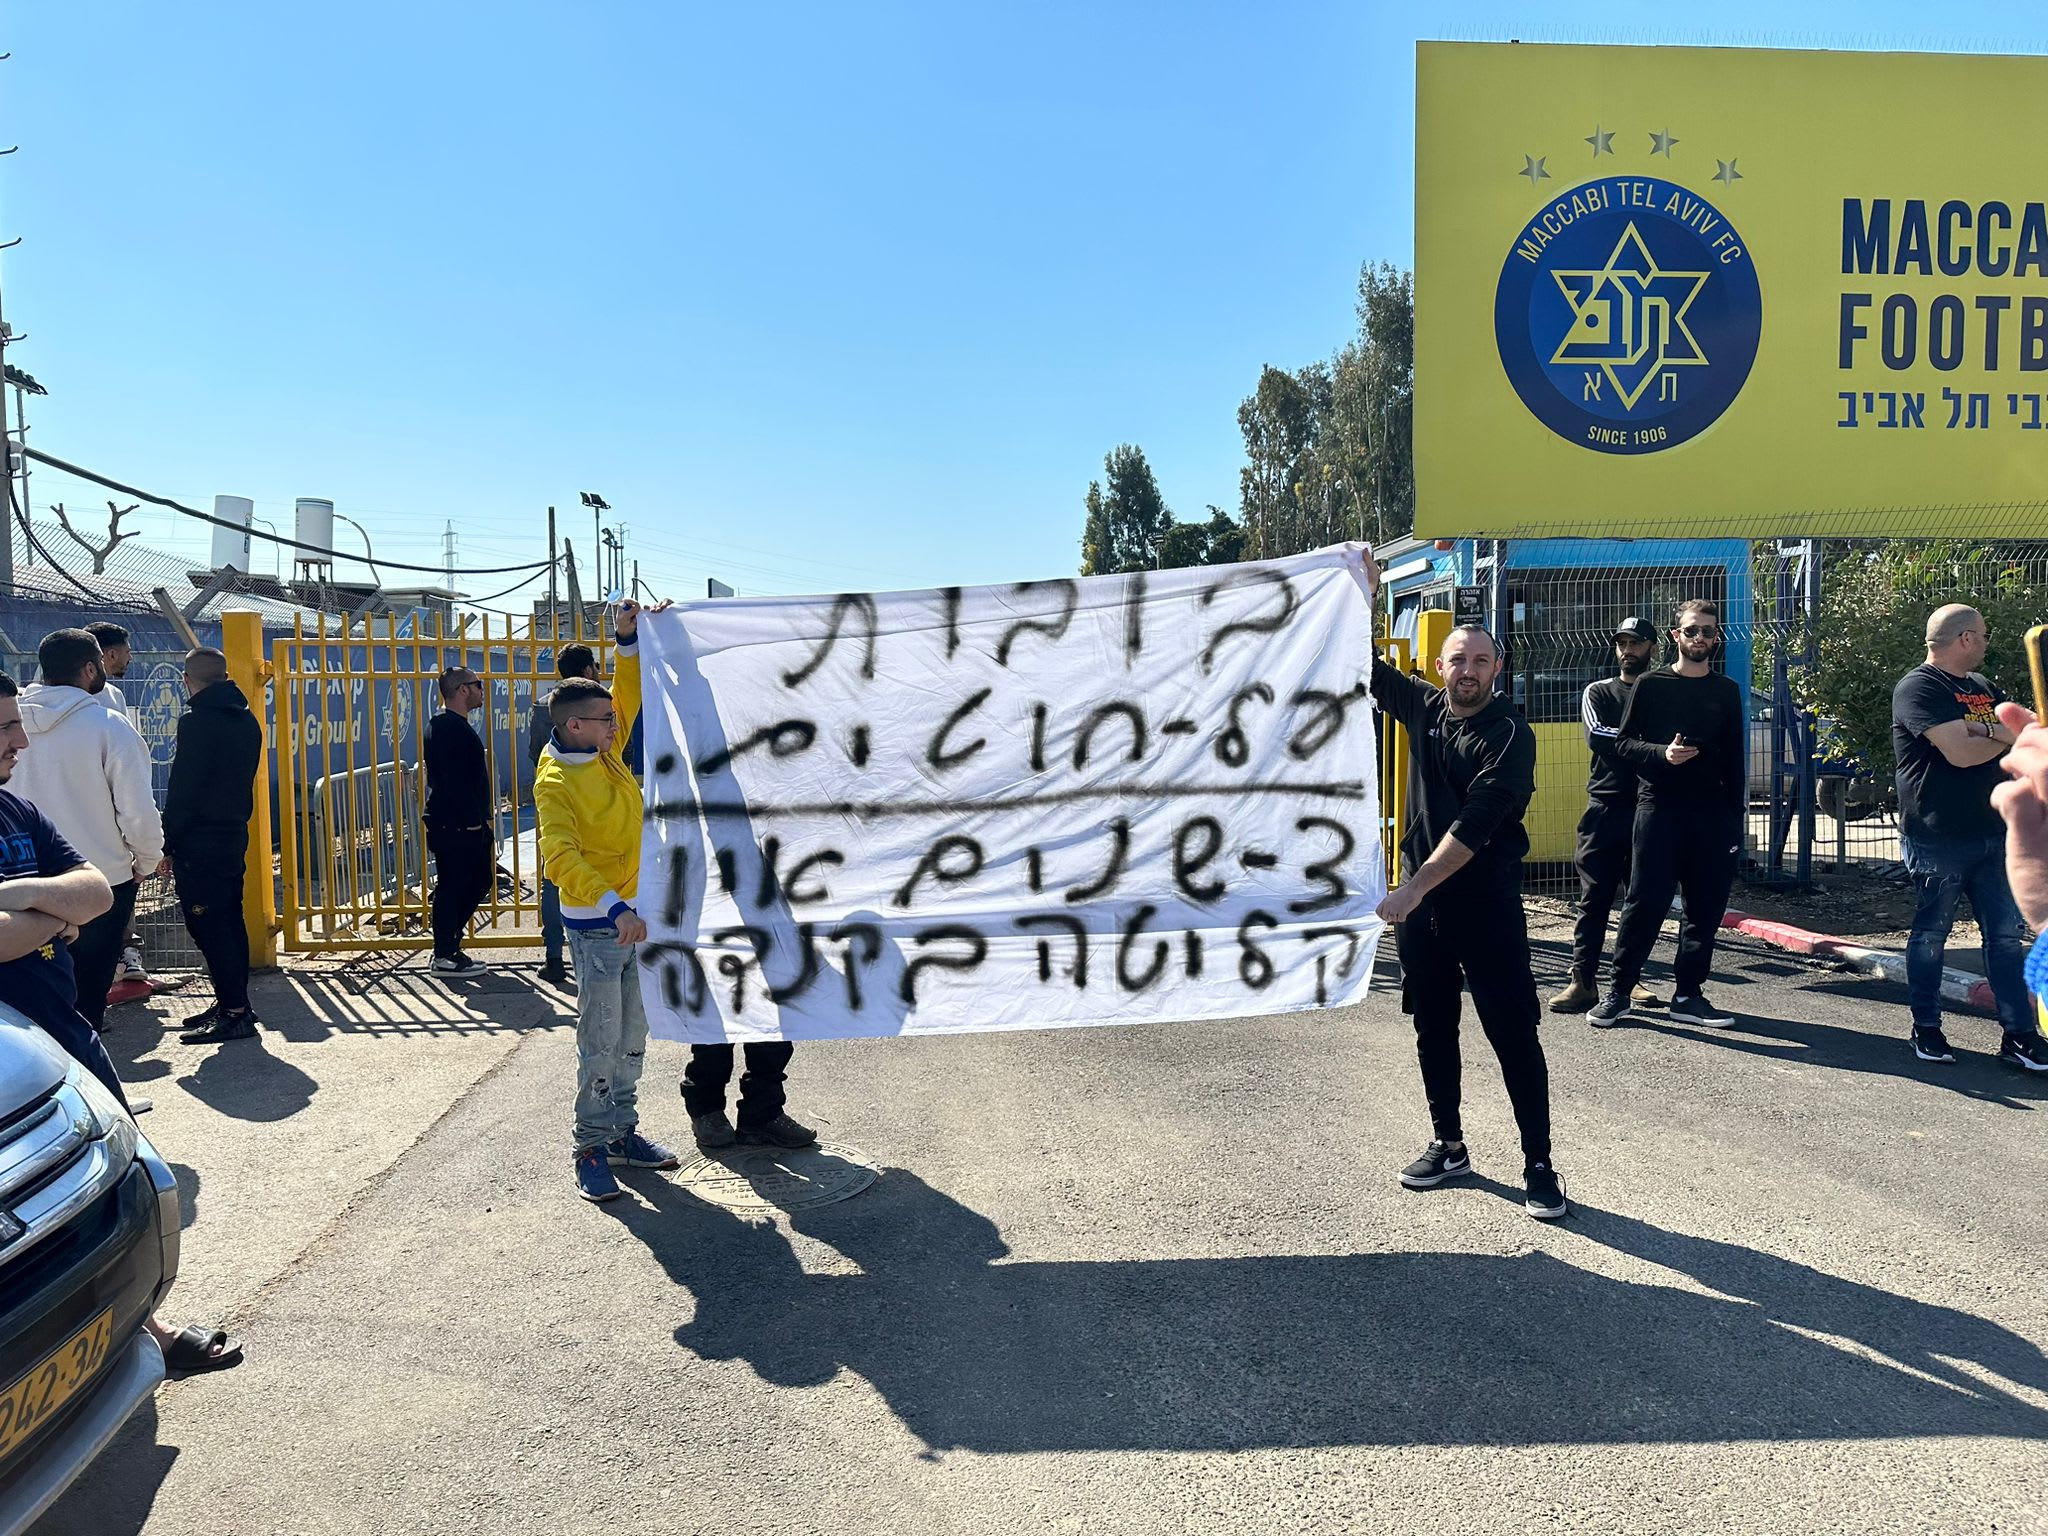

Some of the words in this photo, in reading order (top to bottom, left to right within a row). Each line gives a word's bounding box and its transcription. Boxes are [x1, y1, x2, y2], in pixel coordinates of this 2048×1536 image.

[1516, 184, 1610, 264] MACCABI
[1617, 182, 1656, 208] TEL
[1663, 191, 1720, 236] AVIV
[1711, 231, 1742, 264] FC
[1841, 198, 2048, 277] MACCA
[1838, 293, 2048, 372] FOOTB
[1837, 391, 1926, 429] אביב
[1942, 386, 1990, 429] תל
[2006, 393, 2048, 430] בי
[1587, 425, 1627, 446] SINCE
[1633, 425, 1668, 446] 1906
[782, 568, 1302, 688] בובות
[494, 707, 526, 734] Traiing
